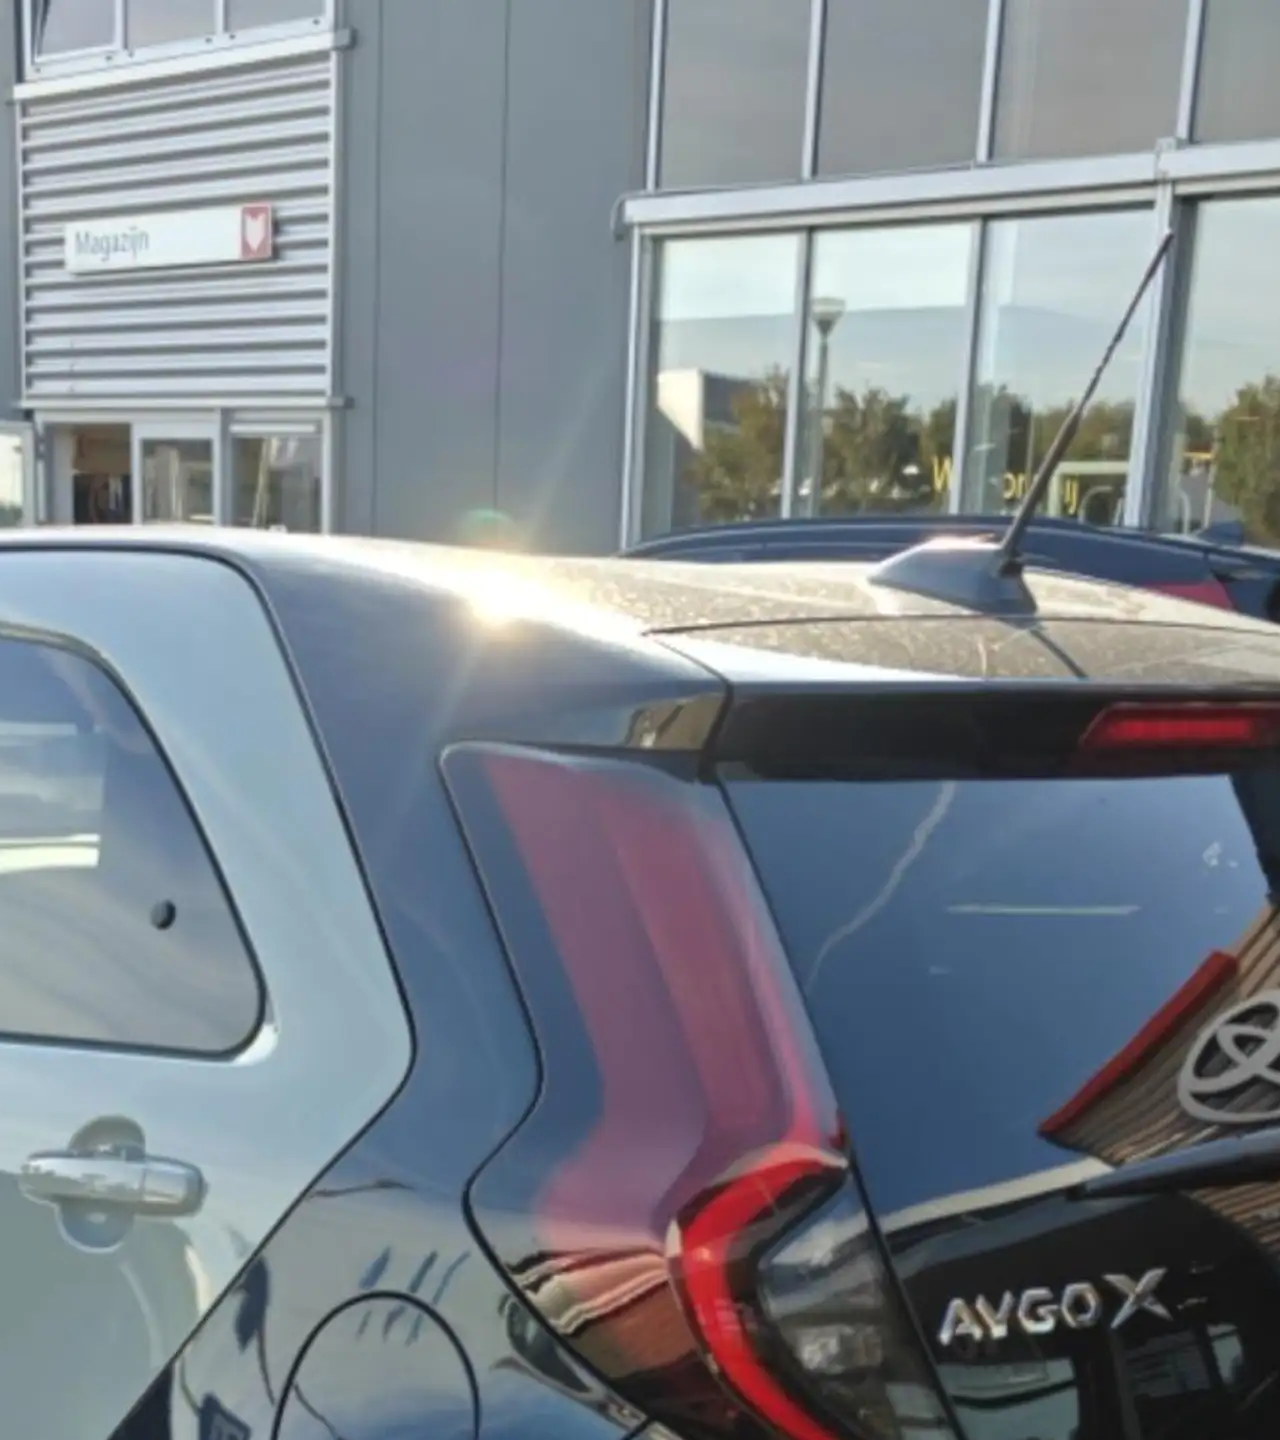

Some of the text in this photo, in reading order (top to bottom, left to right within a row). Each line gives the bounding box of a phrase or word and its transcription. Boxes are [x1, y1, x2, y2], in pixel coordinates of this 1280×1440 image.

[74, 224, 150, 262] Magazijn
[937, 1266, 1174, 1346] AYGO X
